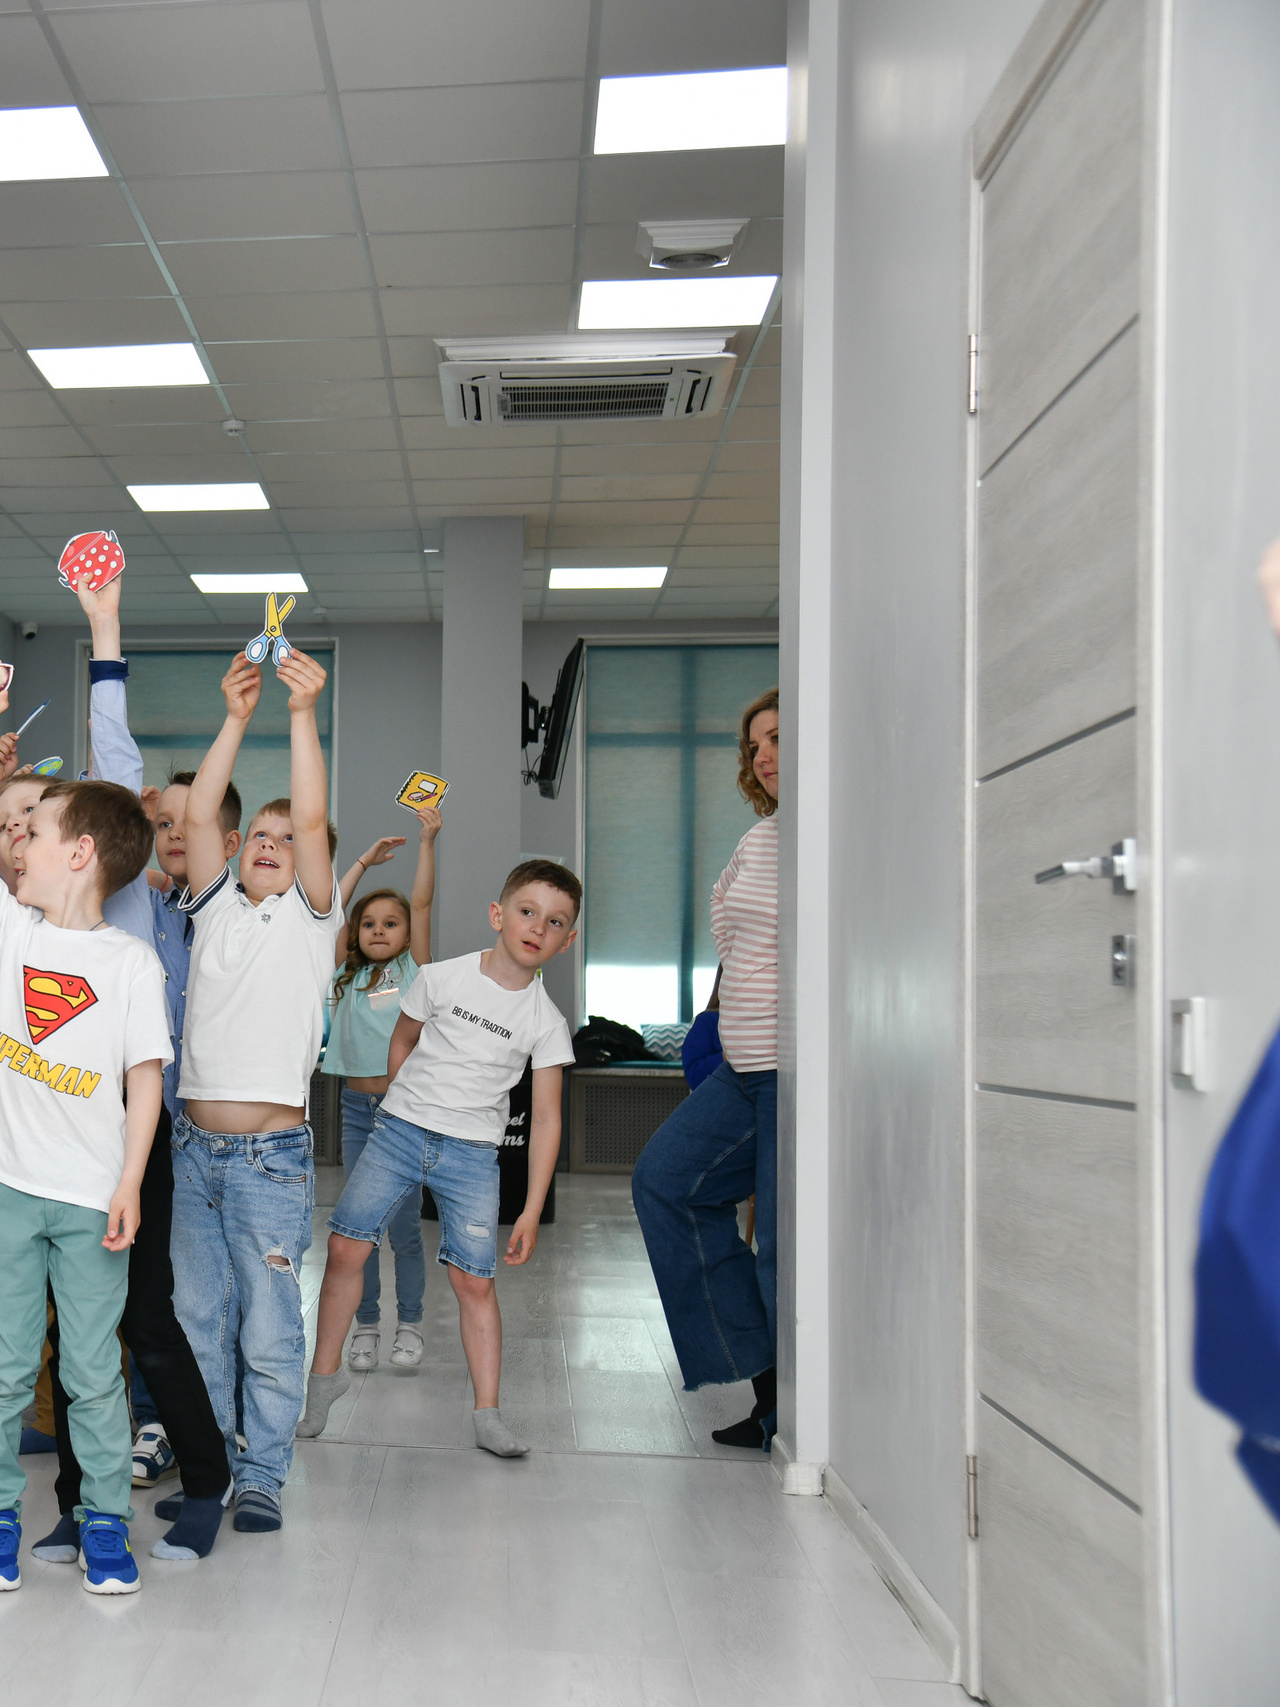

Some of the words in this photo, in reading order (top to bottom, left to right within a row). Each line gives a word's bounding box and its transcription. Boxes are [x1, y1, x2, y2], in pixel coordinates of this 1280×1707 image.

[452, 1006, 462, 1016] BB
[461, 1010, 469, 1019] IS
[468, 1014, 480, 1024] MY
[480, 1019, 512, 1039] TRADITION
